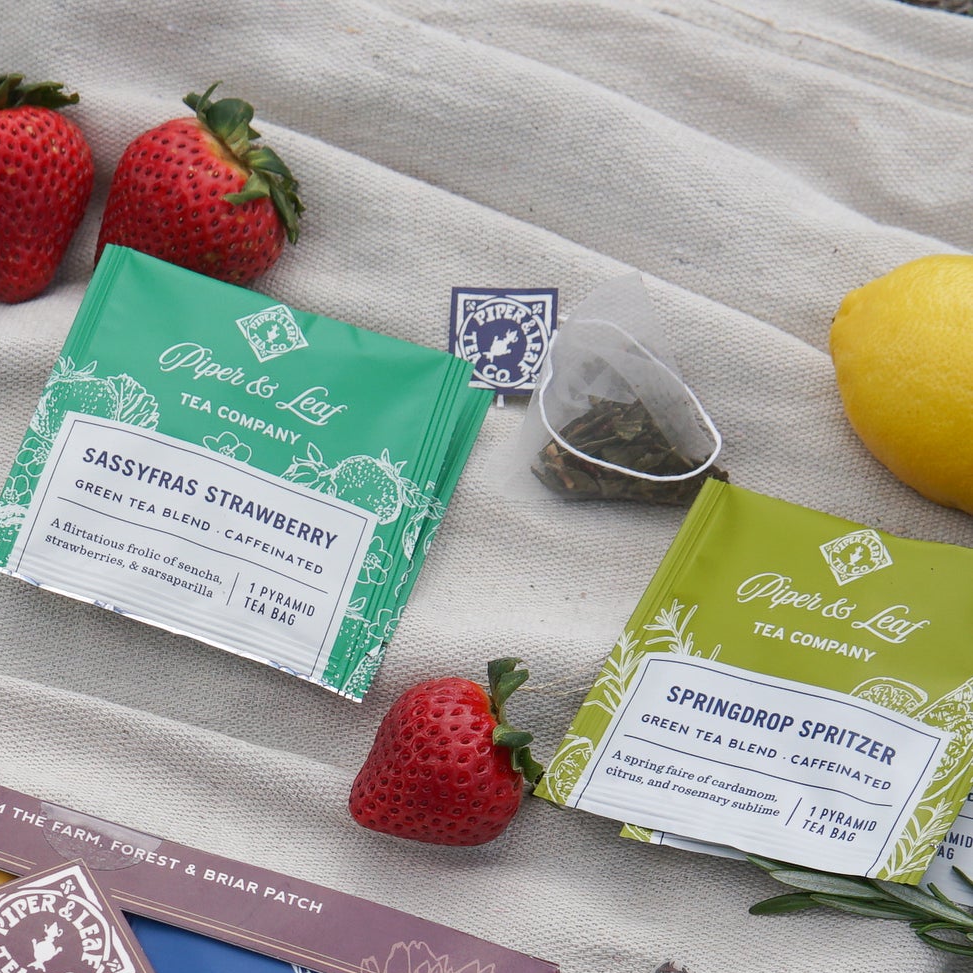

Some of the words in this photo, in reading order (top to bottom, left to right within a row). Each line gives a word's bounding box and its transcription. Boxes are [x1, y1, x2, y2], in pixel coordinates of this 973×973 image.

[157, 341, 245, 388] Piper
[245, 374, 278, 398] &
[276, 385, 348, 427] Leaf
[180, 392, 212, 414] TEA
[217, 405, 302, 446] COMPANY
[75, 479, 123, 504] GREEN
[129, 497, 156, 514] TEA
[161, 507, 211, 531] BLEND
[224, 529, 323, 575] CAFFEINATED
[82, 447, 199, 496] SASSYFRAS
[204, 485, 339, 550] STRAWBERRY
[44, 534, 125, 569] strawberries,
[128, 560, 140, 571] &
[140, 566, 213, 599] sarsaparilla
[50, 517, 61, 529] A
[62, 521, 125, 551] flirtatious
[126, 543, 161, 561] frolic
[162, 556, 179, 567] of
[177, 561, 223, 586] sencha,
[735, 571, 822, 611] Piper
[822, 596, 855, 620] &
[850, 603, 930, 644] Leaf
[753, 621, 785, 641] TEA
[789, 630, 877, 662] COMPANY
[641, 713, 690, 735] GREEN
[696, 728, 722, 745] TEA
[728, 738, 778, 759] BLEND
[790, 754, 892, 790] CAFFEINATED
[666, 685, 795, 733] SPRINGDROP
[798, 719, 896, 766] SPRITZER
[12, 807, 48, 828] THE
[110, 840, 181, 870] FOREST
[184, 863, 196, 876] &
[203, 868, 259, 894] BRIAR
[263, 886, 323, 914] PATCH
[57, 901, 76, 920] &
